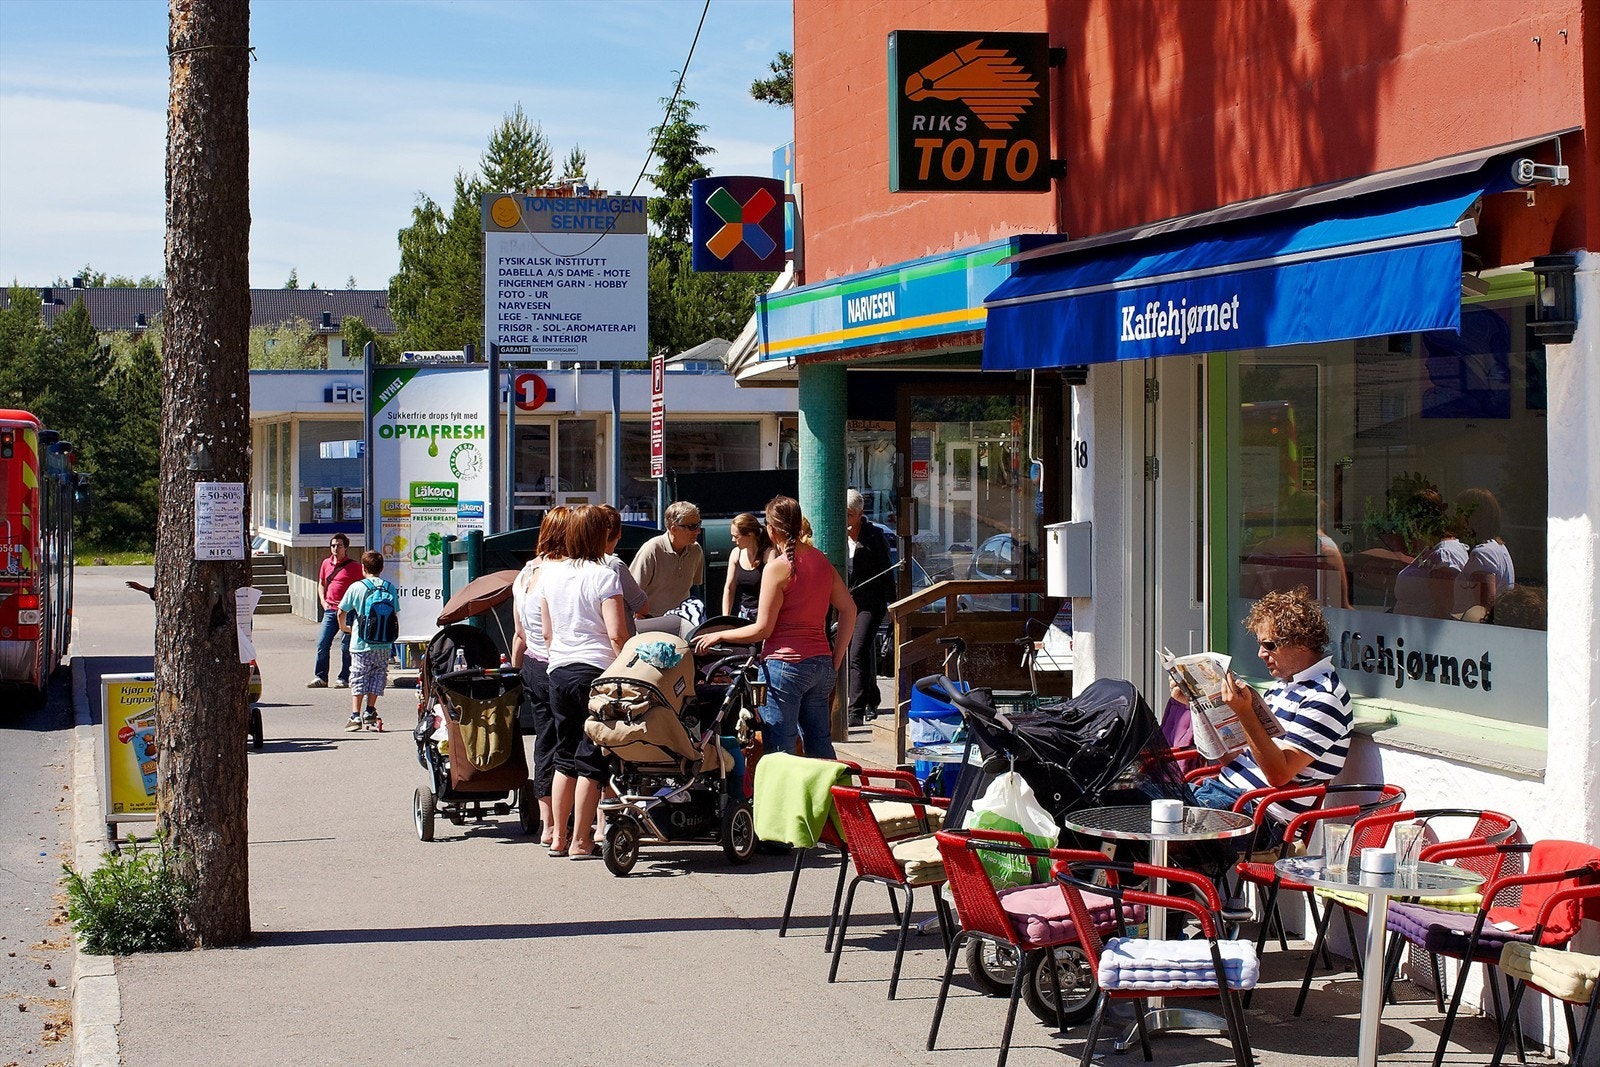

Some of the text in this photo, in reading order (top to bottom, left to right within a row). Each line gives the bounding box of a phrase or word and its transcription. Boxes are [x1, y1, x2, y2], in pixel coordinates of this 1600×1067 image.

[912, 115, 968, 132] RIKS
[914, 138, 1039, 181] TOTO
[523, 198, 643, 214] TONSENHAGEN
[551, 215, 616, 230] SENTER
[498, 257, 607, 267] FYSIKALSK INSTITUTT
[498, 268, 543, 277] DABELLA
[547, 268, 564, 278] A/S
[566, 269, 594, 278] DAME
[603, 269, 631, 278] MOTE
[498, 279, 554, 288] FINGERNEM
[556, 280, 586, 289] GARN
[594, 280, 628, 289] HOBBY
[498, 290, 526, 299] FOTO
[535, 291, 549, 299] UR
[498, 301, 551, 310] NARVESEN
[847, 290, 895, 324] NARVESEN
[498, 312, 522, 321] LEGE
[532, 313, 582, 321] TANNLEGE
[1120, 294, 1239, 345] Kaffehjørnet
[498, 323, 533, 332] FRISØR
[498, 334, 588, 344] FARGE & INTERIØR
[332, 382, 364, 404] Eie
[379, 377, 405, 403] NYHET
[521, 380, 535, 407] 1
[387, 411, 478, 421] Sukkerfrie drops fylt med
[378, 424, 485, 440] OPTAFRESH
[1074, 440, 1089, 469] 18
[414, 485, 455, 499] Läkerol
[412, 586, 431, 600] deg
[1340, 630, 1492, 692] ffehjørnet
[121, 686, 144, 695] Kjøp
[120, 695, 156, 705] Lynpak
